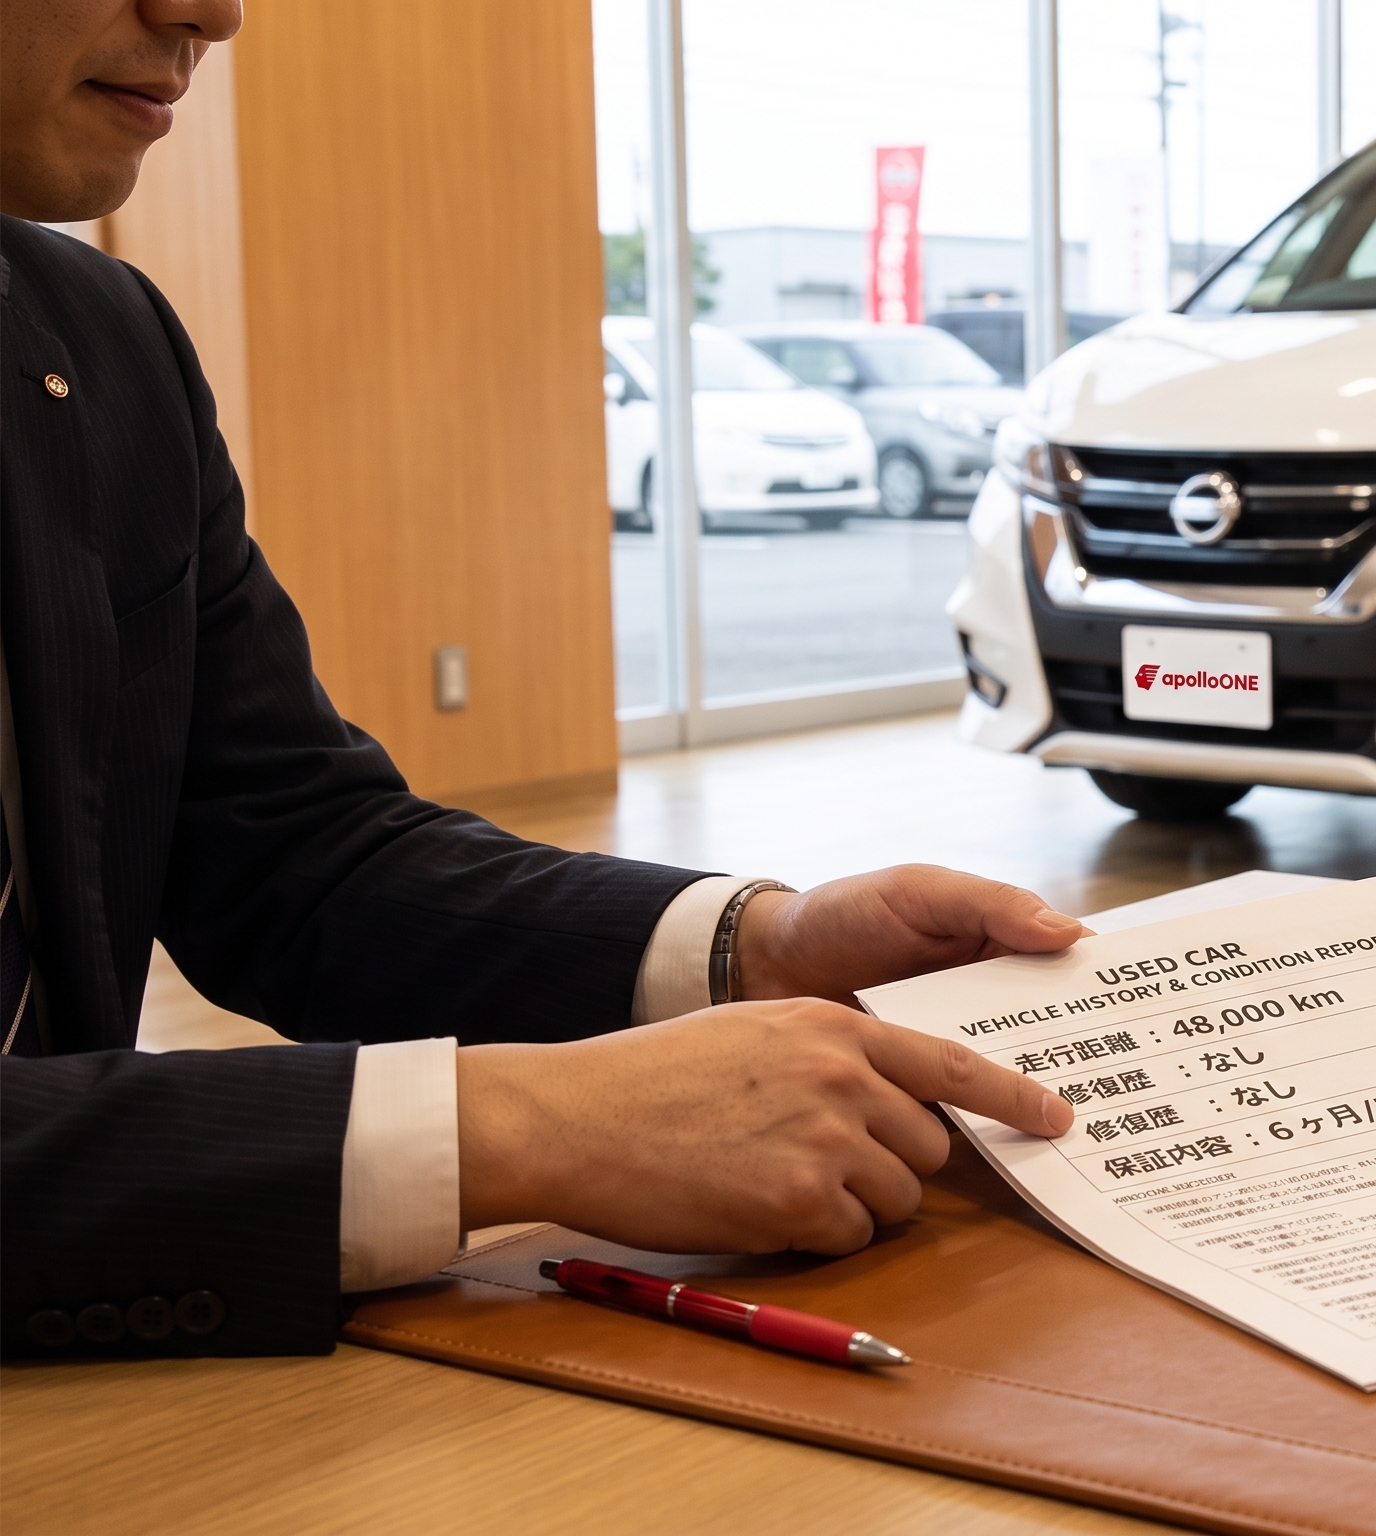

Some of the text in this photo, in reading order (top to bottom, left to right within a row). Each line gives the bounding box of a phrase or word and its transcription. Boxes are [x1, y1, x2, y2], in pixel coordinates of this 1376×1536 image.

[1161, 670, 1259, 691] apolloONE
[1095, 942, 1248, 985] USED CAR
[959, 1004, 1063, 1037] VEHICLE
[1063, 982, 1163, 1015] HISTORY
[1168, 978, 1189, 992] &
[1190, 950, 1314, 987] CONDITION
[1172, 999, 1285, 1038] 48,000
[1288, 989, 1345, 1012] km
